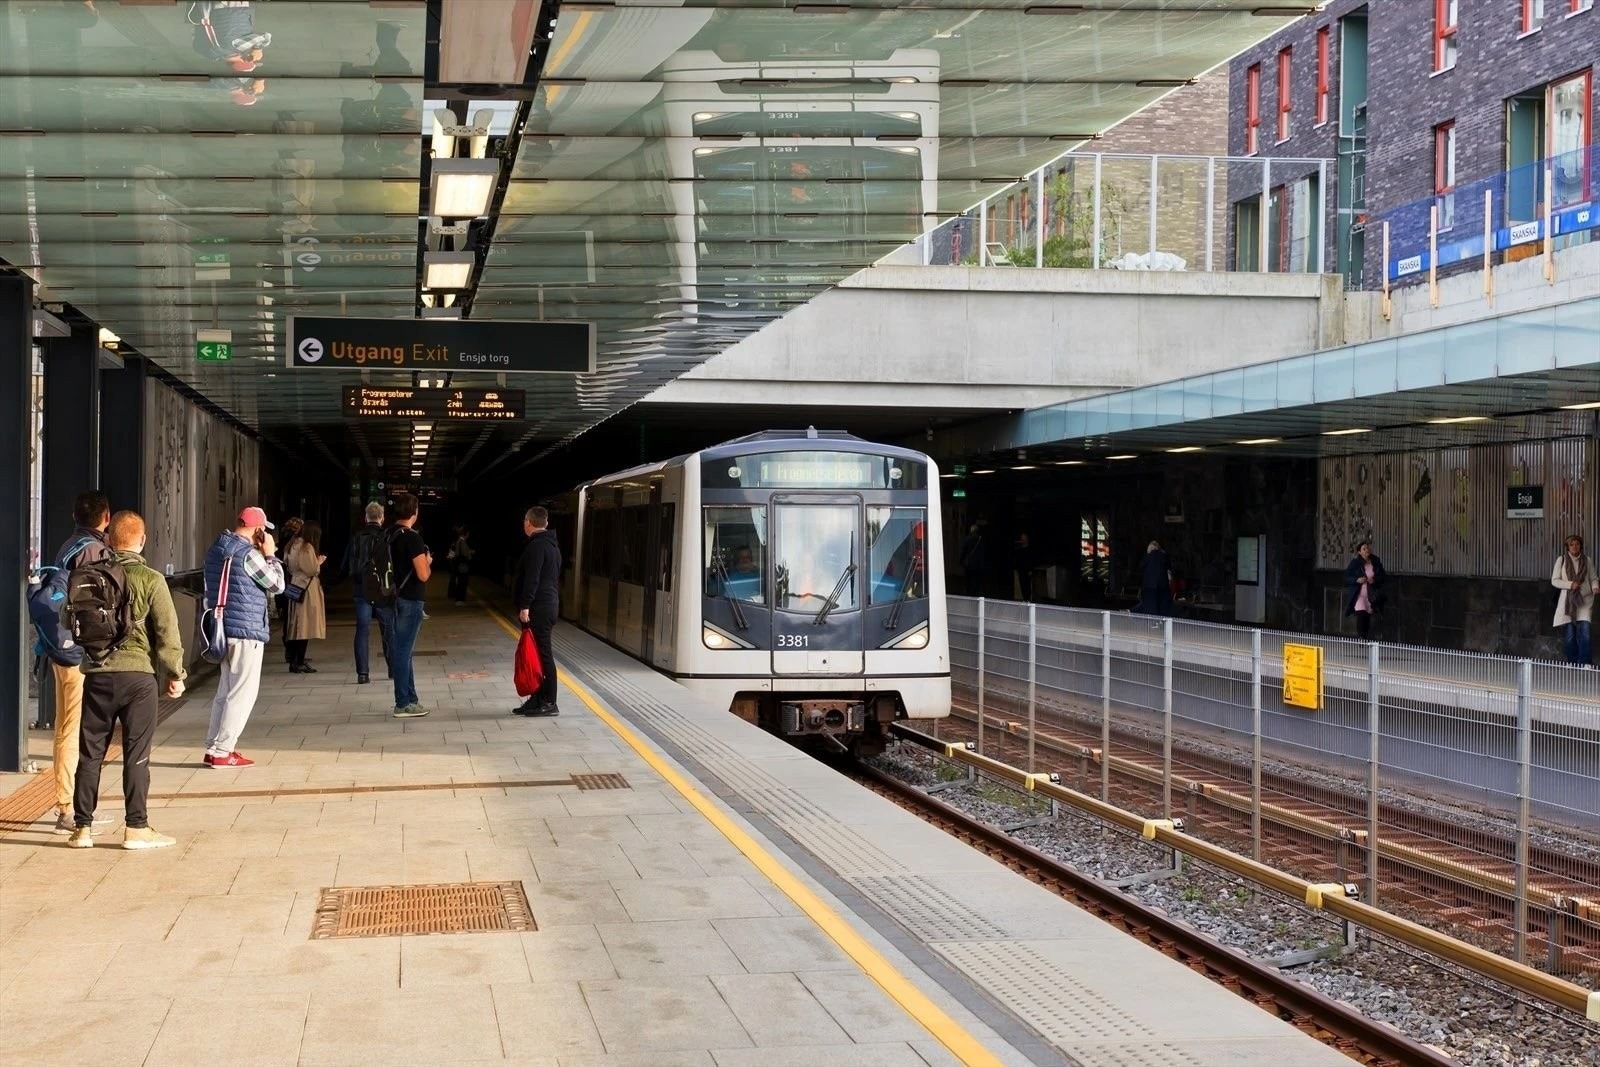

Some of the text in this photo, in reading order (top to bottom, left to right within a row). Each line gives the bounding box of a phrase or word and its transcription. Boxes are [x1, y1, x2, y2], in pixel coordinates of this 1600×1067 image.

[1512, 226, 1536, 241] SKANSKA
[332, 341, 510, 365] Utgang Exit Ensjø torg
[777, 634, 809, 647] 3381
